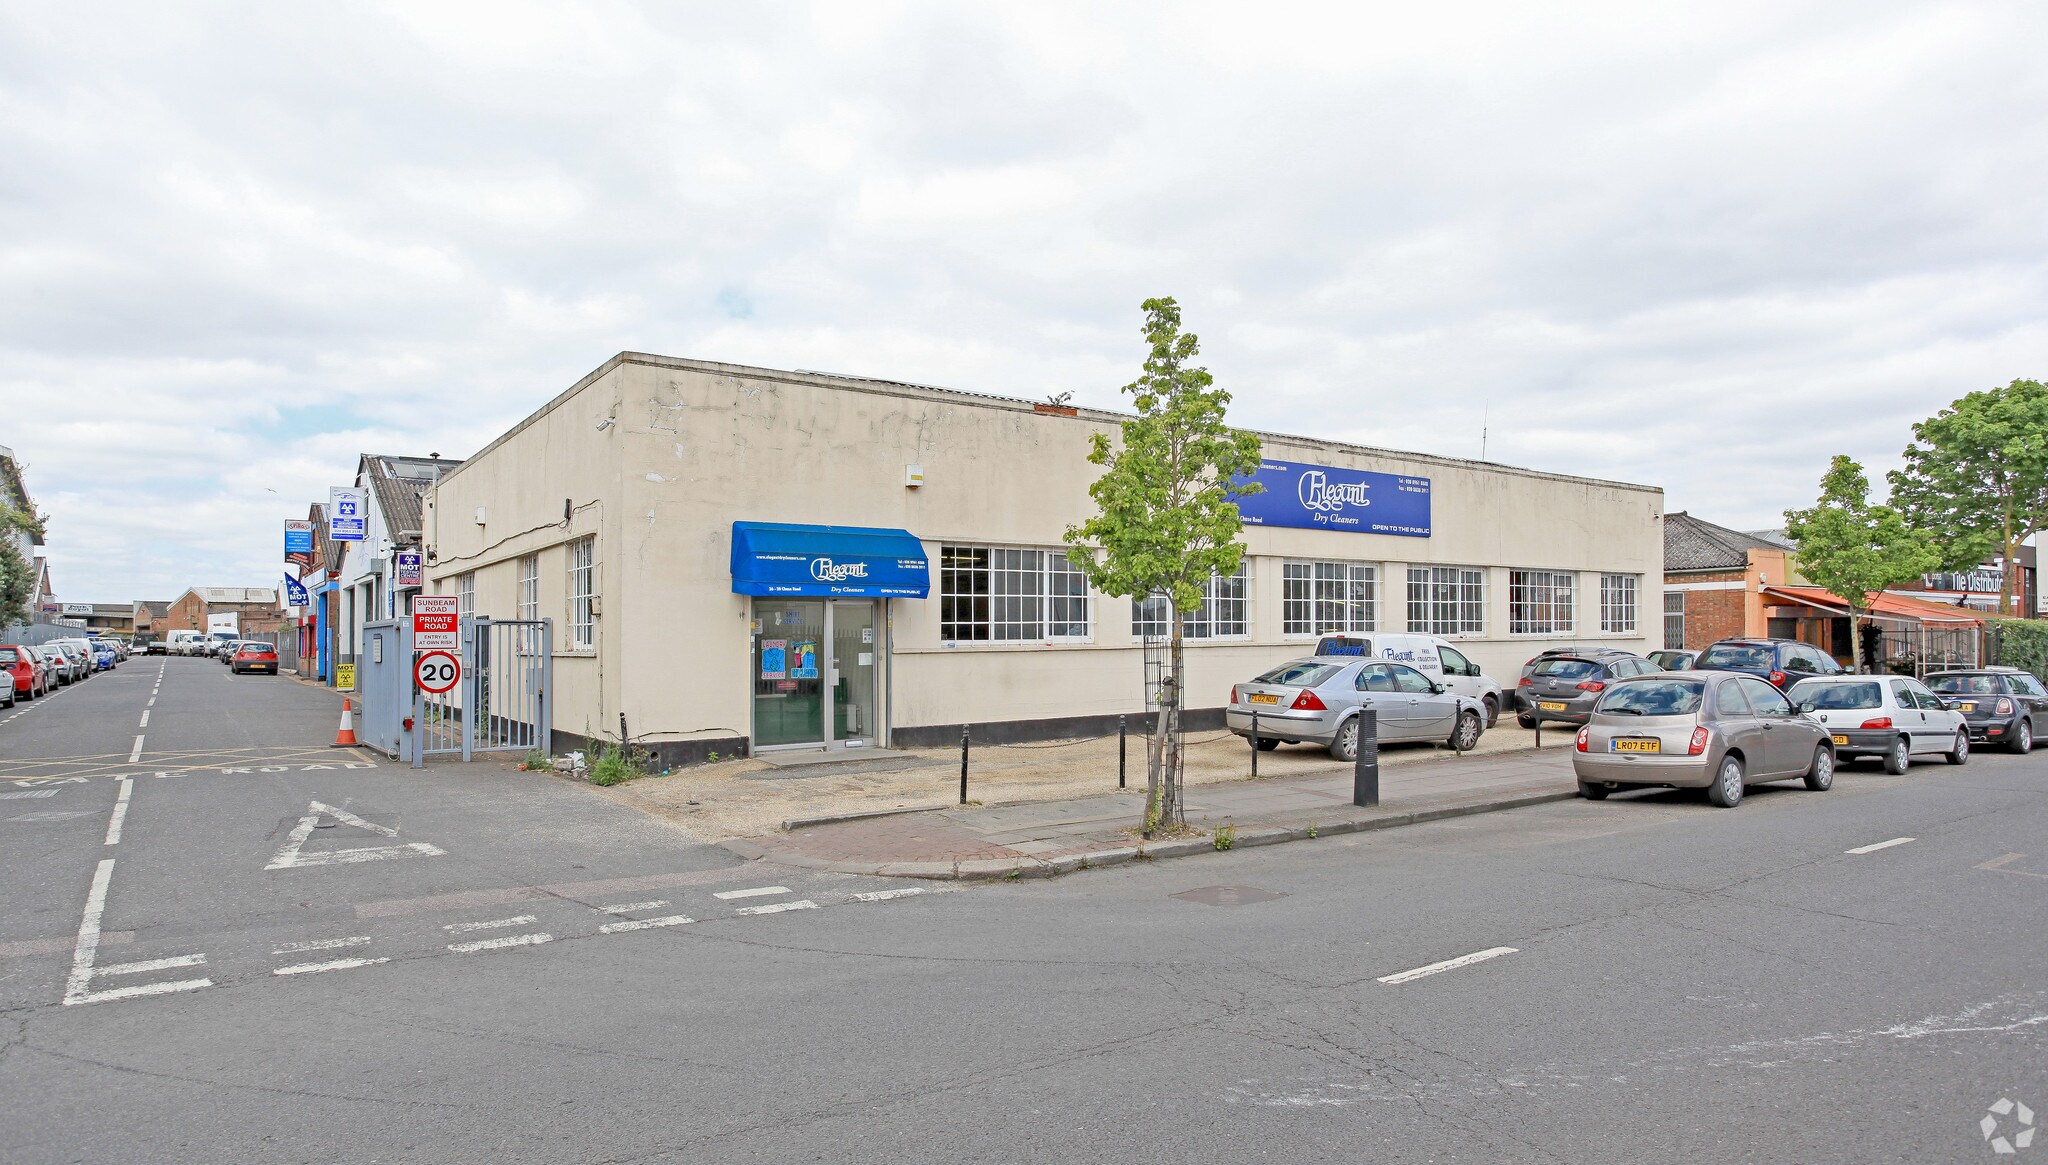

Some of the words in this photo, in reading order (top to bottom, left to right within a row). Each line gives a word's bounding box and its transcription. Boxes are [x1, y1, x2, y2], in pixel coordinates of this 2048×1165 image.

[1298, 470, 1370, 511] Elegant
[1314, 512, 1328, 524] Dry
[1330, 514, 1358, 524] Cleaners
[810, 558, 868, 581] Elegant
[1382, 648, 1415, 662] Elegant
[422, 664, 455, 681] 20
